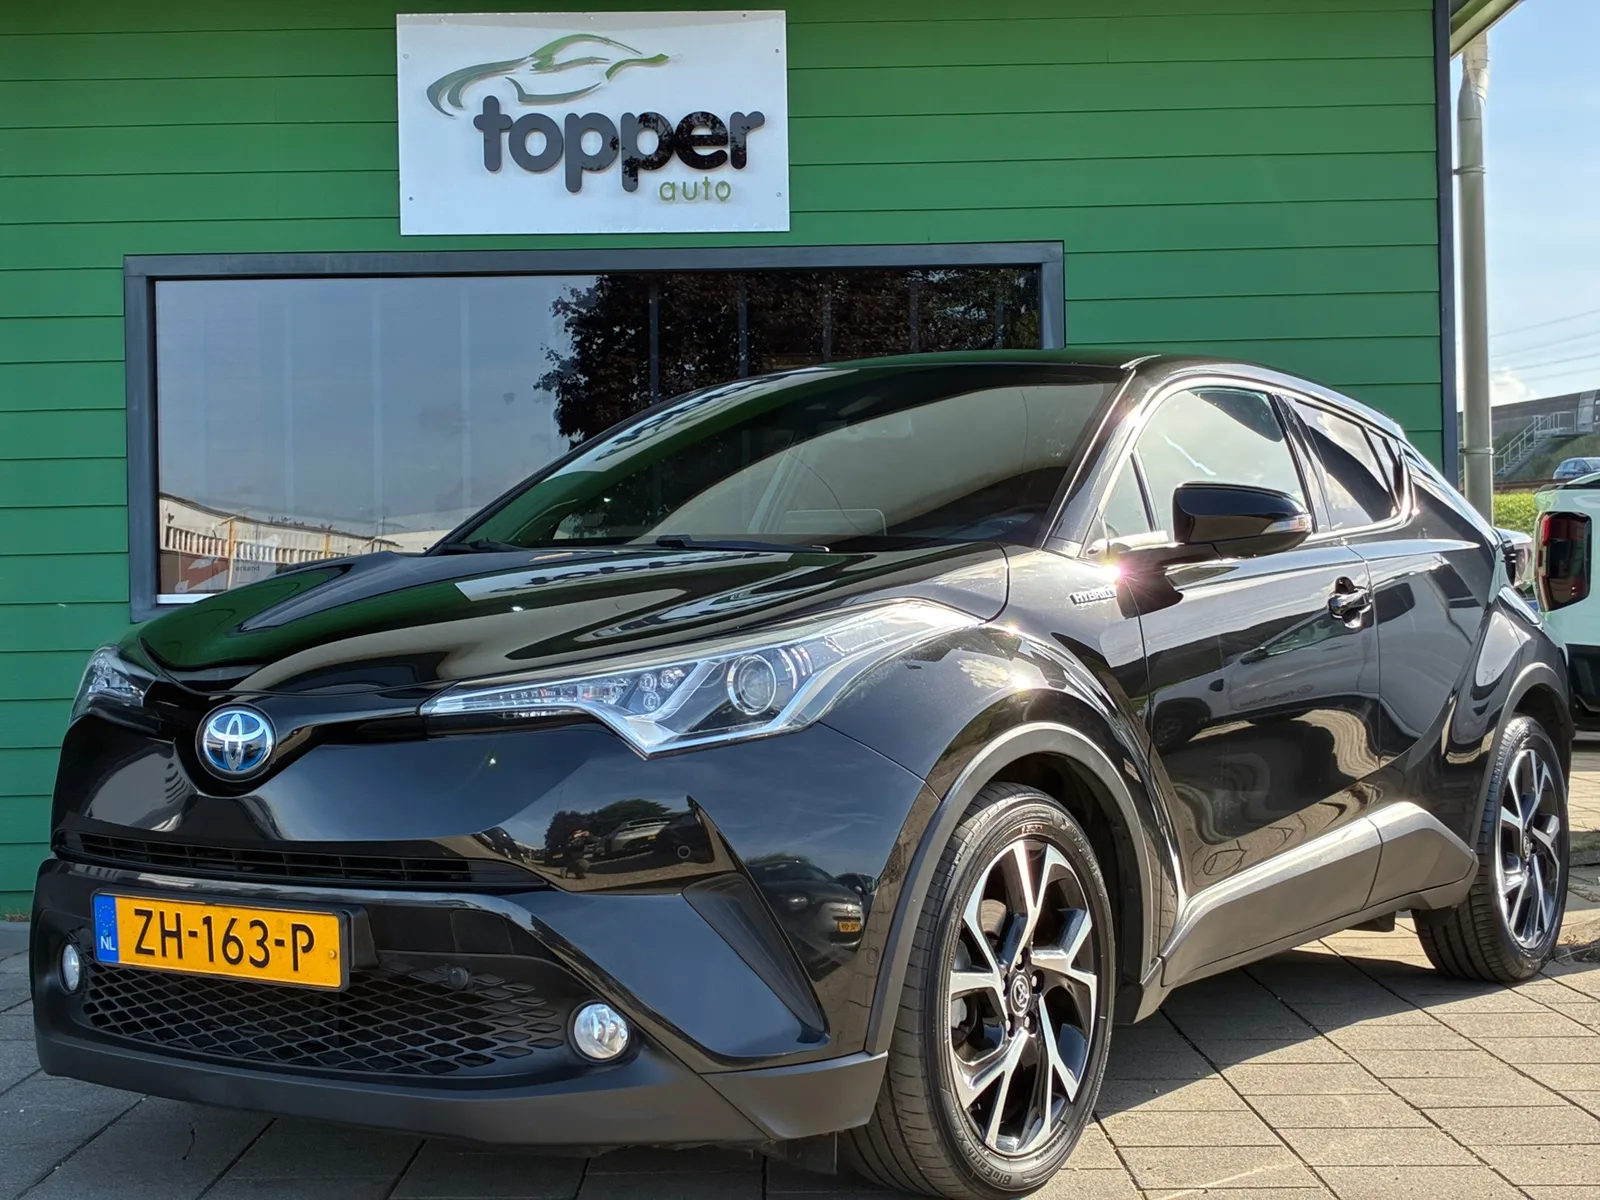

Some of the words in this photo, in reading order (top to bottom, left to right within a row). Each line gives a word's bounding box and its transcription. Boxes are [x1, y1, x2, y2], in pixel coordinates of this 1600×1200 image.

[473, 95, 765, 193] topper
[659, 176, 731, 201] auto
[100, 935, 116, 951] NL
[133, 908, 315, 972] ZH-163-P
